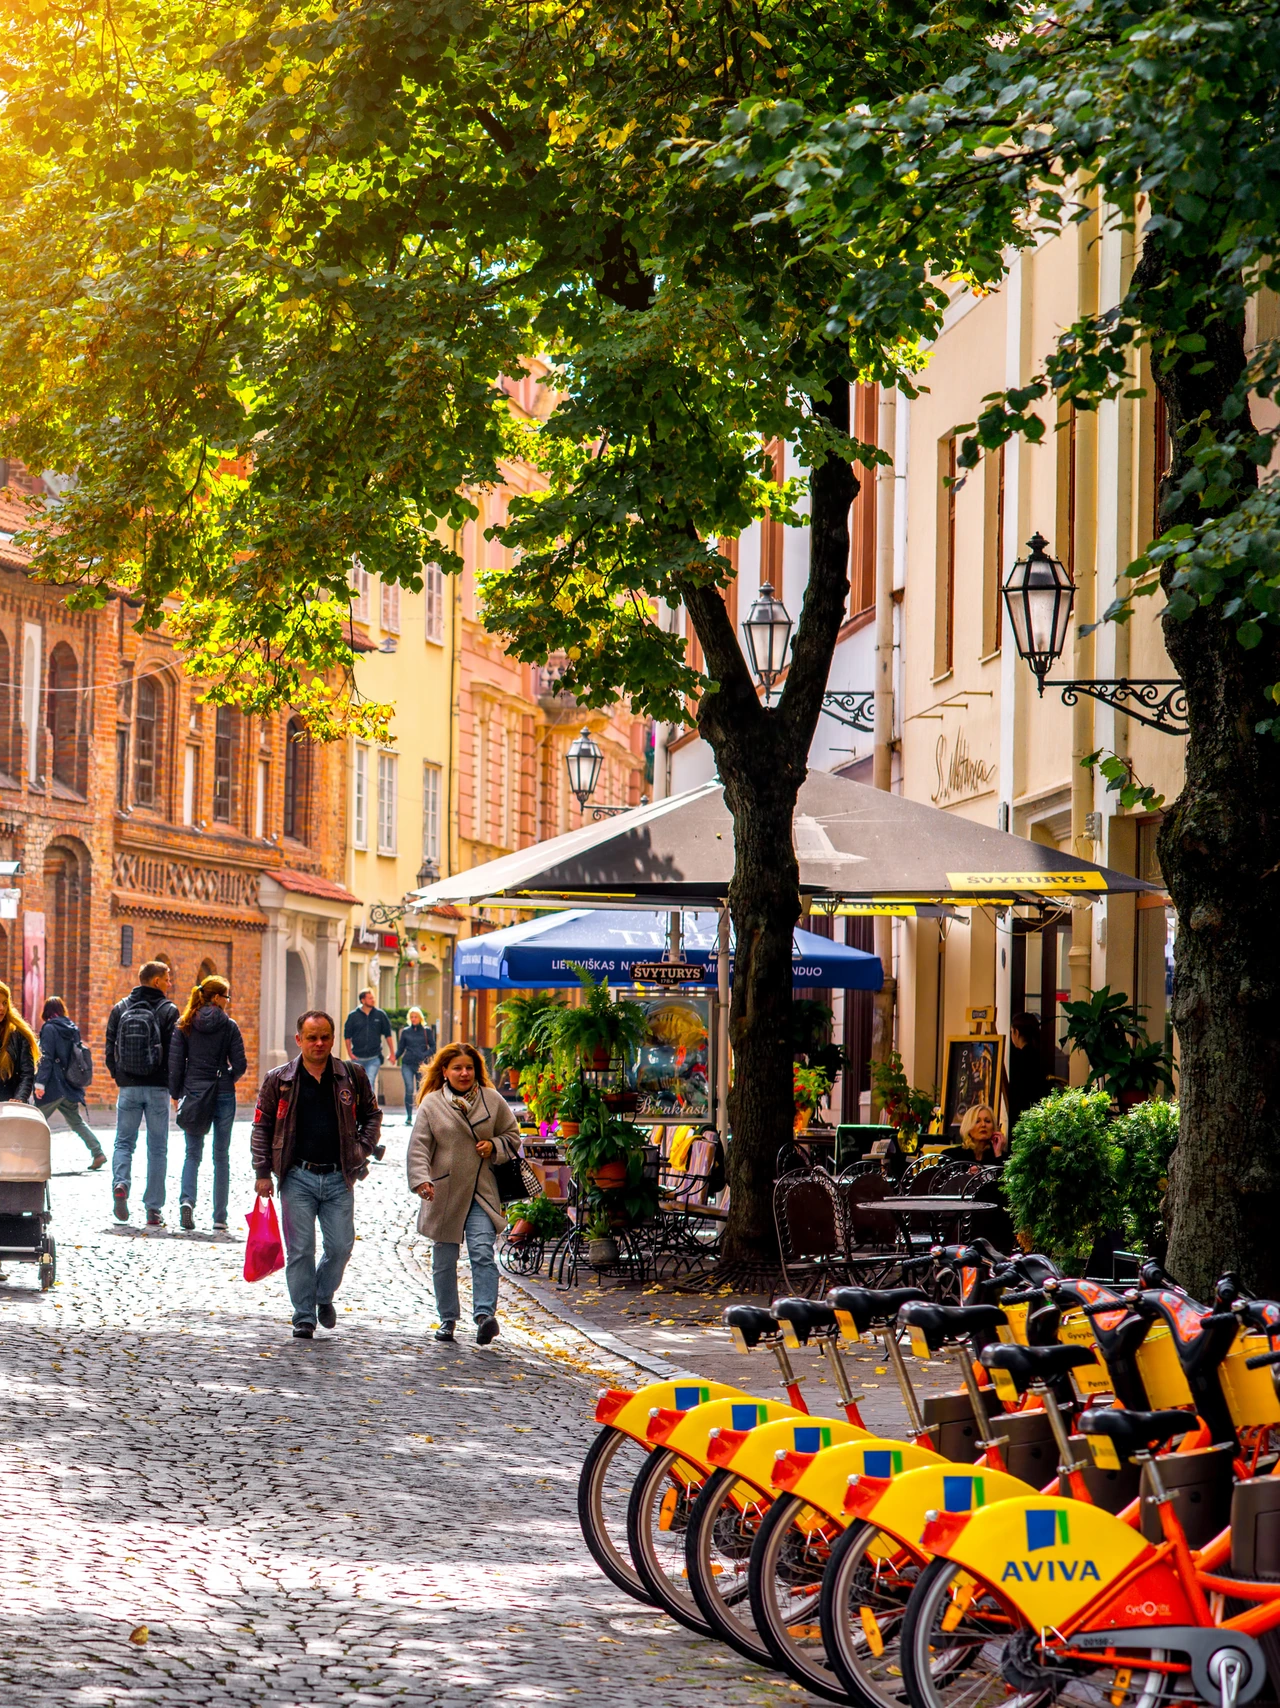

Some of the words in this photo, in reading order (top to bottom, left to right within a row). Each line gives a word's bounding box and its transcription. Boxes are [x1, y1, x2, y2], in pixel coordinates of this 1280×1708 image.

[967, 875, 1086, 884] ŠVYTURYS
[634, 965, 701, 979] ŠVYTURYS
[793, 967, 822, 977] NDUO
[1001, 1560, 1101, 1582] AVIVA
